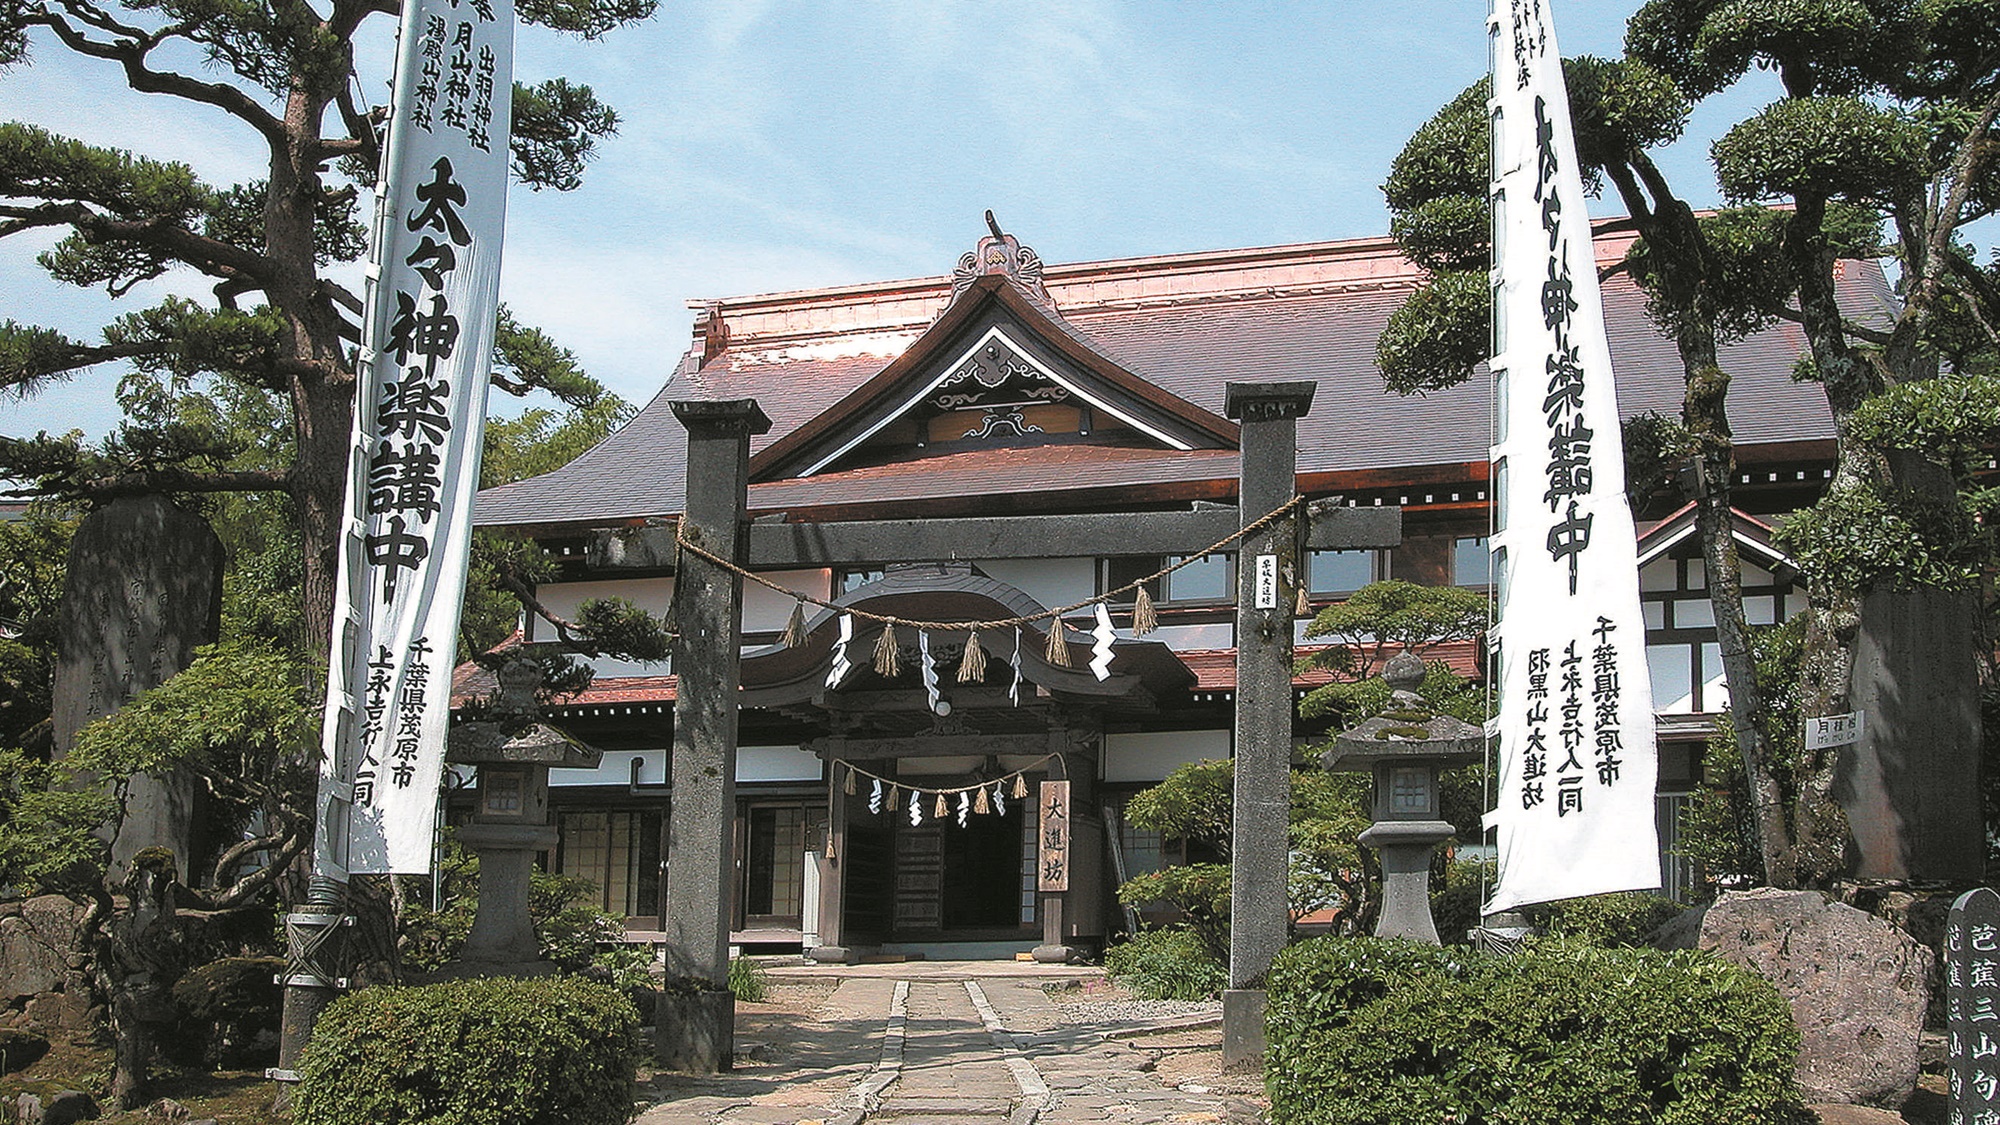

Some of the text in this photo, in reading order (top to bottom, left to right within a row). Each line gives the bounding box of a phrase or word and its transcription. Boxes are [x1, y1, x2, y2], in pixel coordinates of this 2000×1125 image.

[440, 21, 473, 131] 月山神社
[467, 44, 496, 154] 出羽神社
[364, 156, 472, 605] 太々神楽講中
[391, 637, 433, 789] 千葉県茂原市
[1044, 798, 1065, 882] 大進坊
